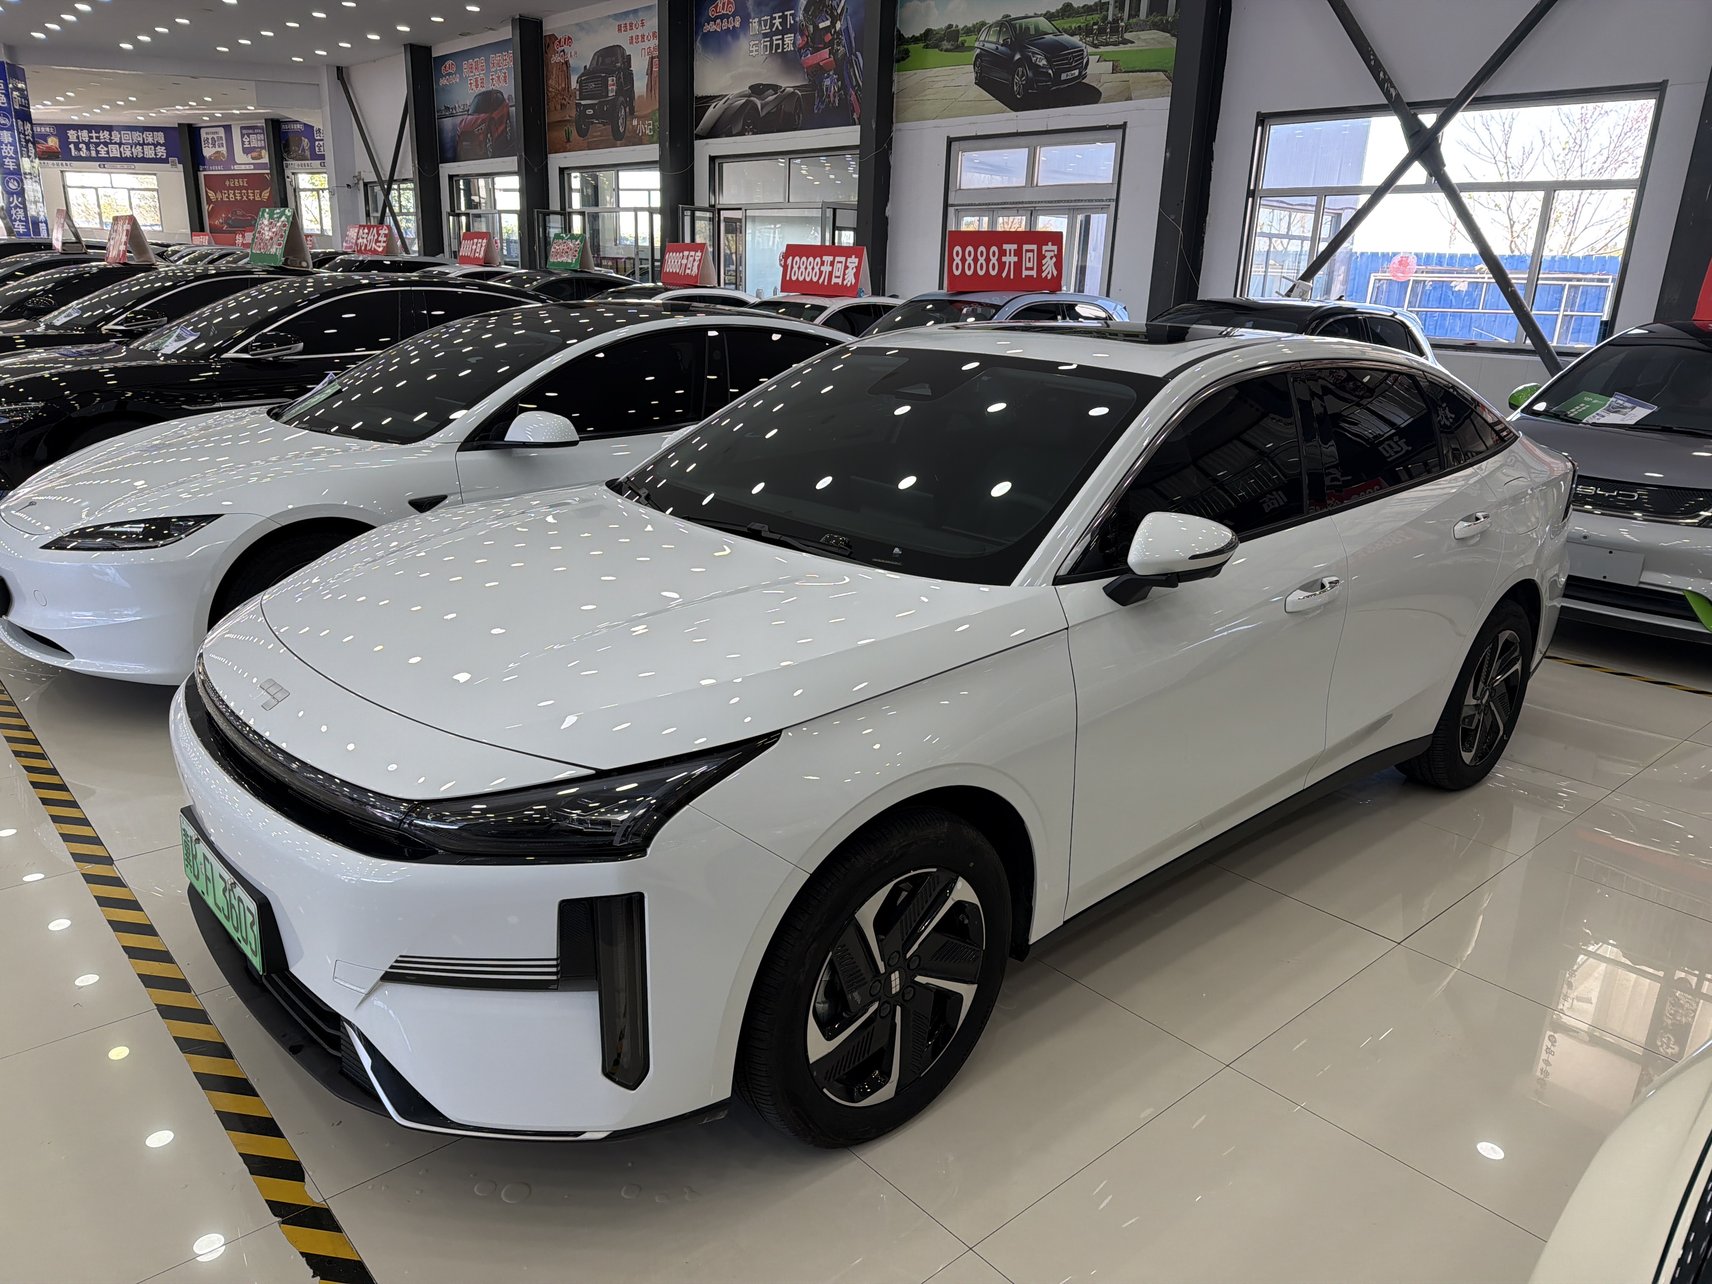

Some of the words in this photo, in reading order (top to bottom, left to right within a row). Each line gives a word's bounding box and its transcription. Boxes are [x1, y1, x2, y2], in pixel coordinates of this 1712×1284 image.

[749, 33, 795, 57] 车行万家
[66, 129, 165, 145] 查博士终身回购保障
[216, 189, 262, 201] 小记名车交车区
[9, 194, 27, 233] 火烧车
[357, 225, 389, 252] 特价车
[786, 254, 859, 288] 18888开回家
[952, 242, 1058, 280] 8888开回家
[1575, 484, 1639, 502] BYD
